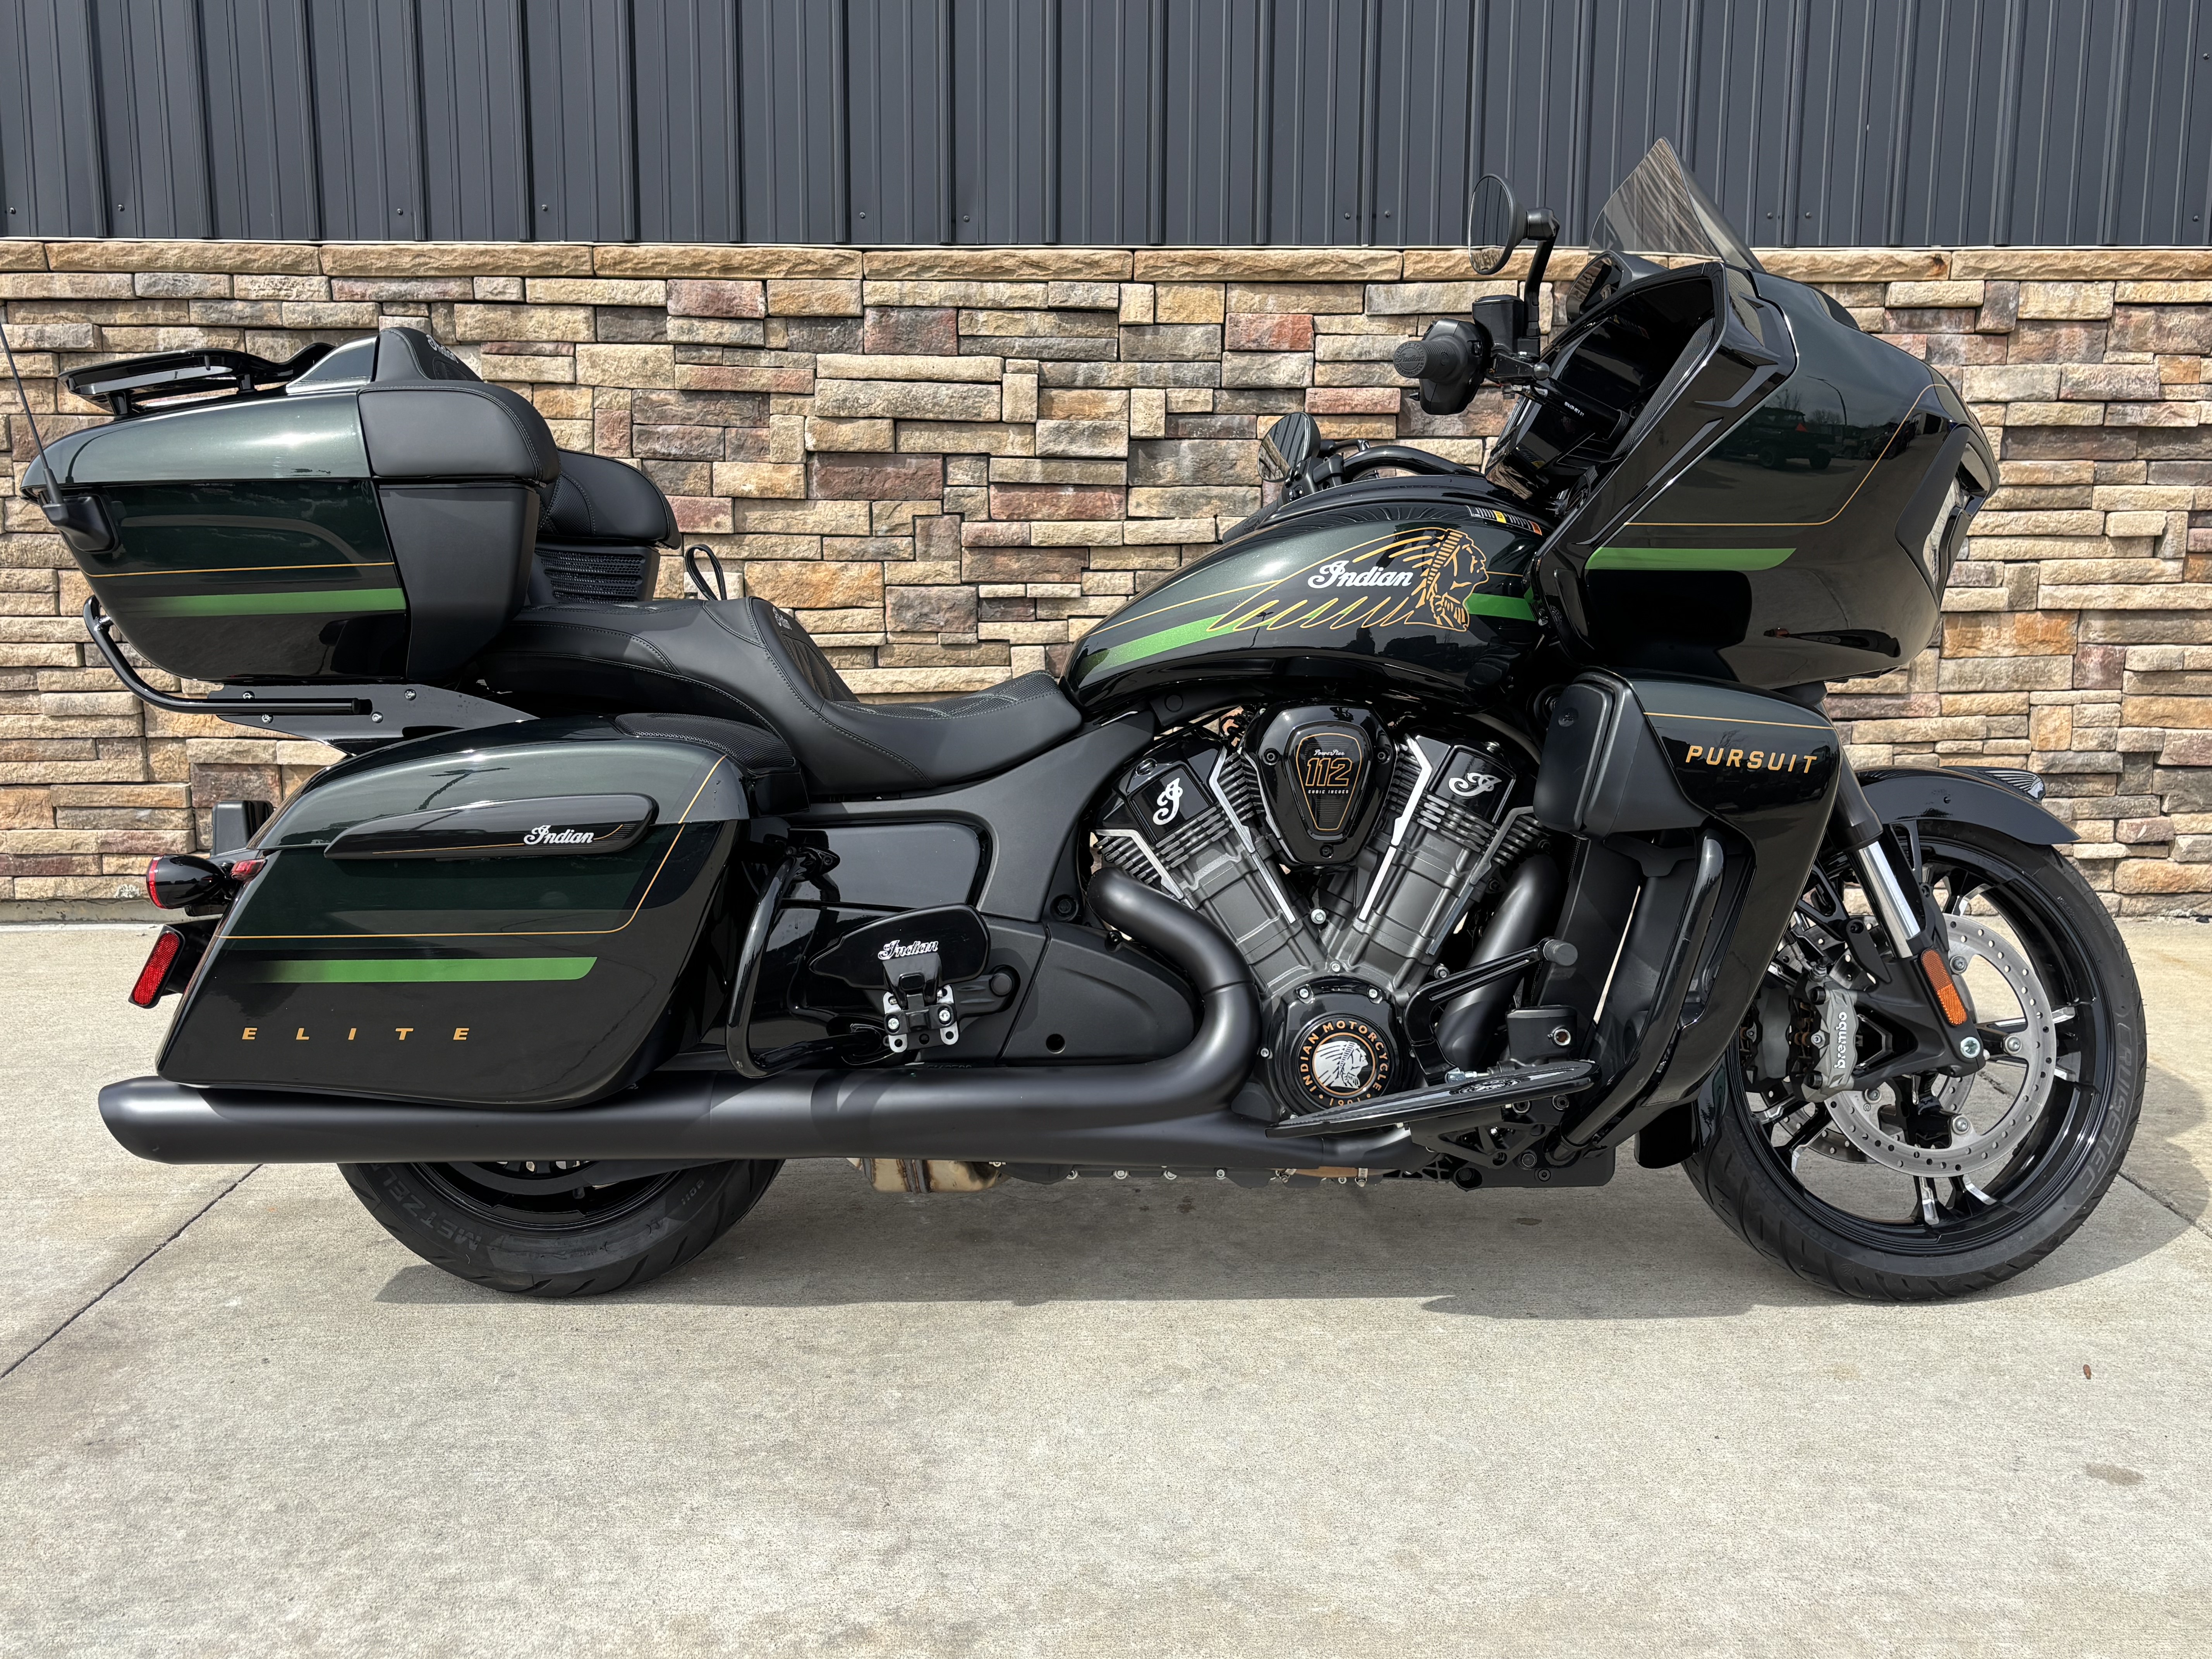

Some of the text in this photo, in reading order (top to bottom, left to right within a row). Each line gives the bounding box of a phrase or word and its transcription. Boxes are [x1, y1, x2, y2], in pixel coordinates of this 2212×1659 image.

[1395, 353, 1425, 362] Indian
[1308, 560, 1413, 589] Indian
[1305, 757, 1353, 787] 112
[1685, 745, 1817, 773] PURSUIT
[524, 825, 594, 845] Indian
[878, 939, 939, 960] Indian
[242, 1027, 469, 1040] ELITE
[1834, 1012, 1847, 1069] brembo
[1300, 1020, 1388, 1092] INDIAN MOTORCYCLE
[2079, 1022, 2133, 1190] CRUISETEC
